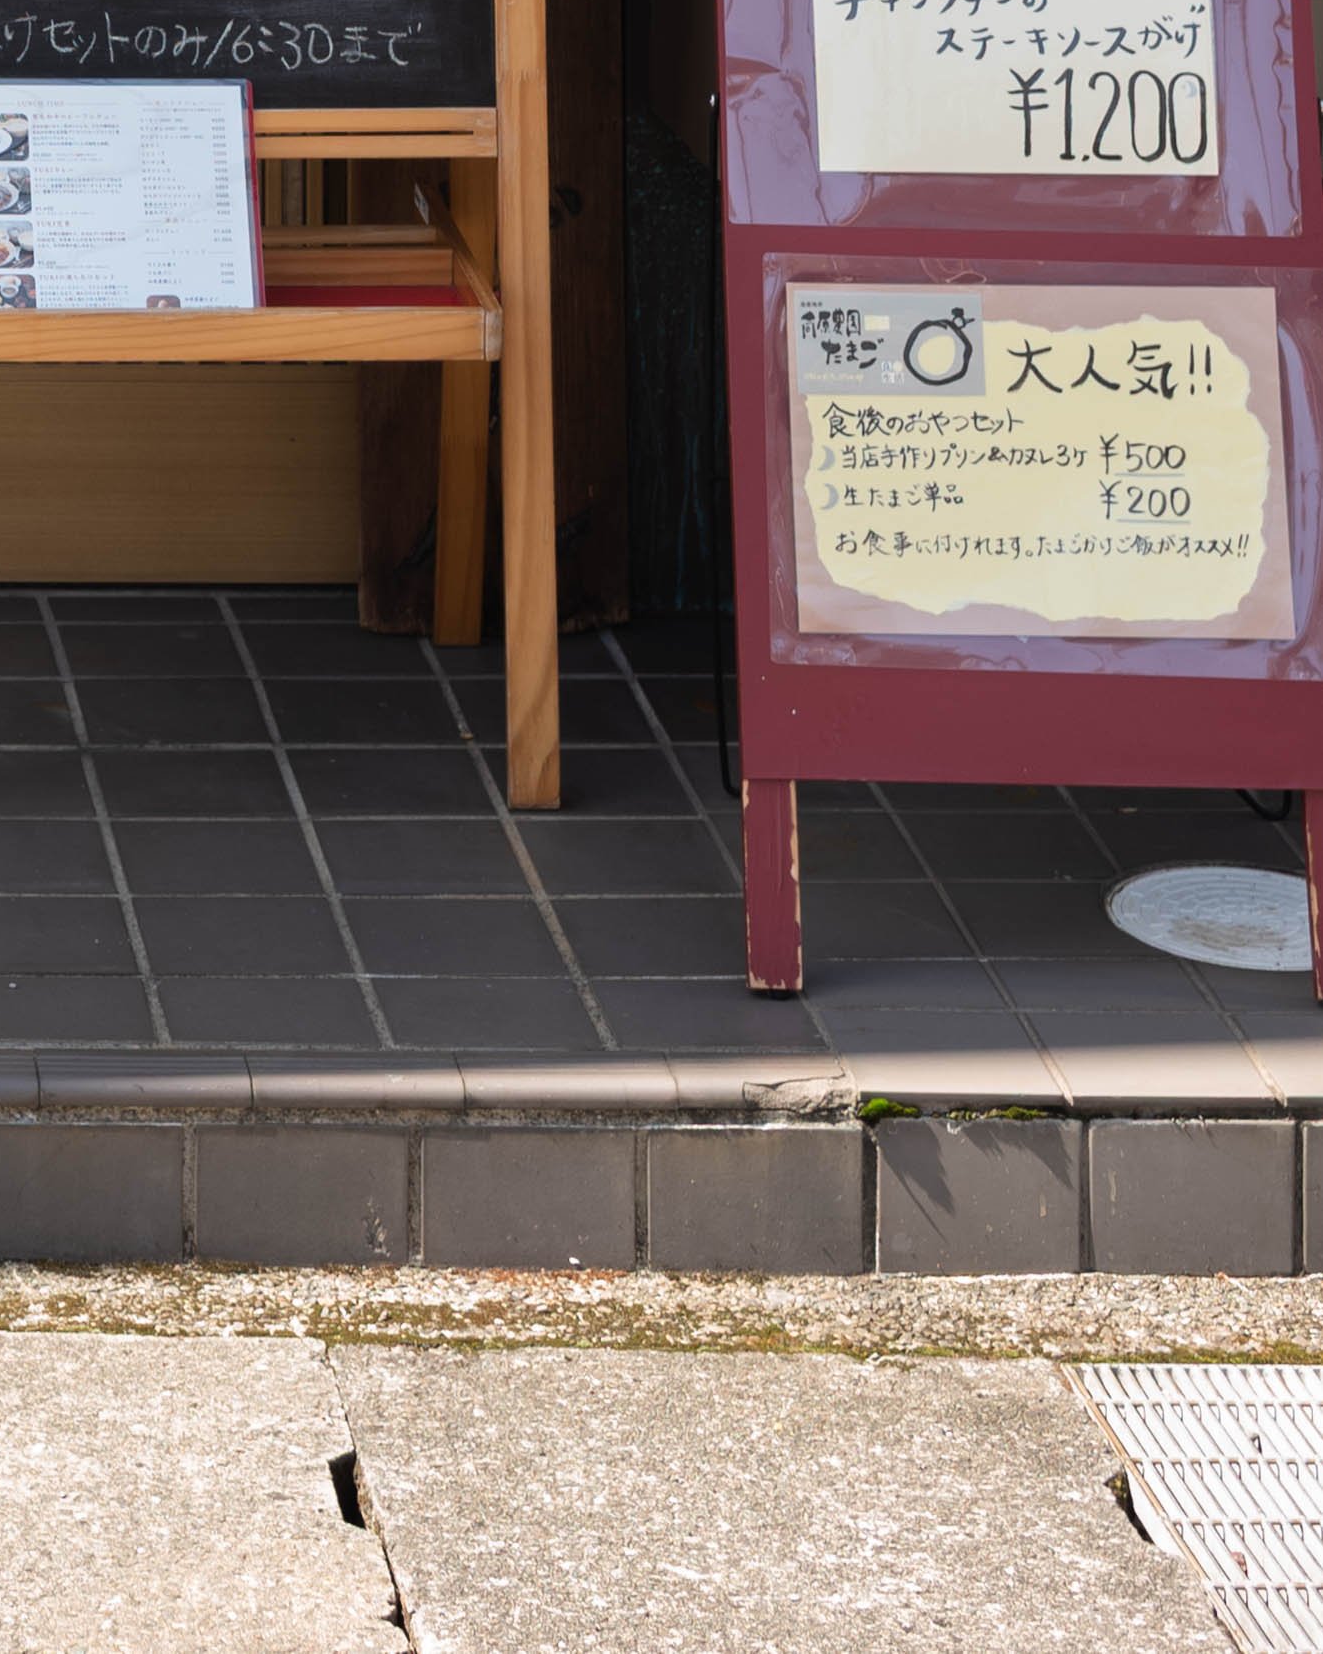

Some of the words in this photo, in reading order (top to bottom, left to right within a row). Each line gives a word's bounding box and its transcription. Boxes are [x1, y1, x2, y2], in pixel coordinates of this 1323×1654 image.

[820, 338, 885, 370] たまご
[821, 401, 1026, 439] 食後のおやつセット
[1099, 433, 1187, 474] ¥500
[841, 481, 966, 511] 生たまご単品
[1099, 479, 1192, 520] ¥200
